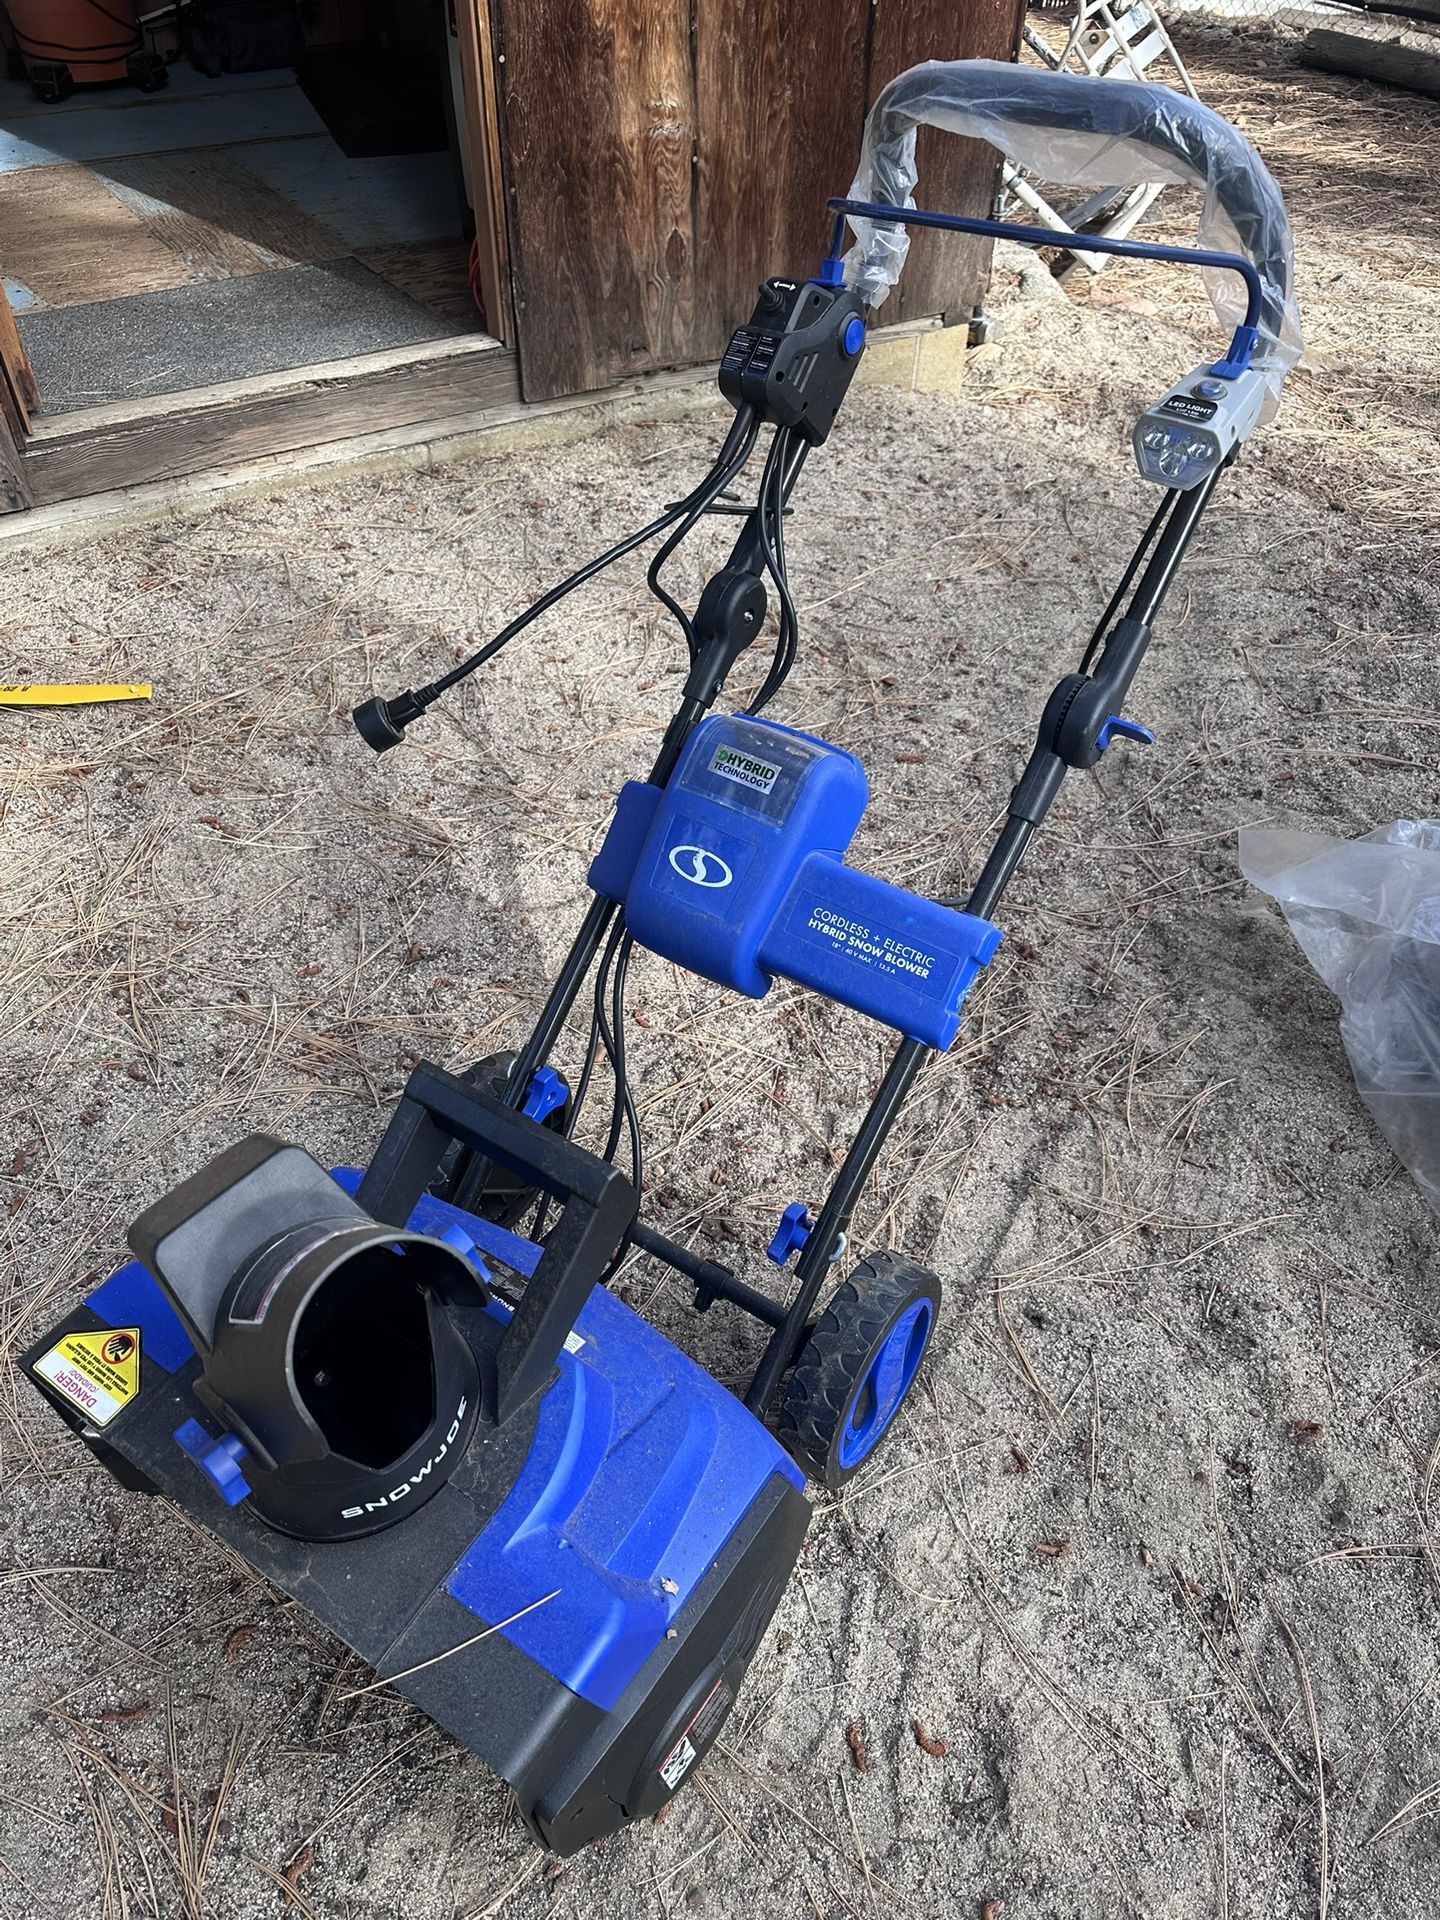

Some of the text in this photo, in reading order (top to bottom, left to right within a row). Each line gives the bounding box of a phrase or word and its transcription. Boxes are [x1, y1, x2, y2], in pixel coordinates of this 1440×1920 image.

[1187, 404, 1213, 415] LIGHT
[714, 761, 769, 789] TECHNOLOGY
[726, 753, 776, 781] HYBRID
[808, 918, 930, 979] HYBRID SNOW BLOWER
[813, 907, 871, 939] CORDLESS
[884, 938, 936, 968] ELECTRIC
[858, 954, 872, 964] MAX
[53, 1370, 97, 1408] DANGER!
[68, 1368, 99, 1394] ¡CUIDADO!
[341, 1395, 468, 1519] SNOWJOE
